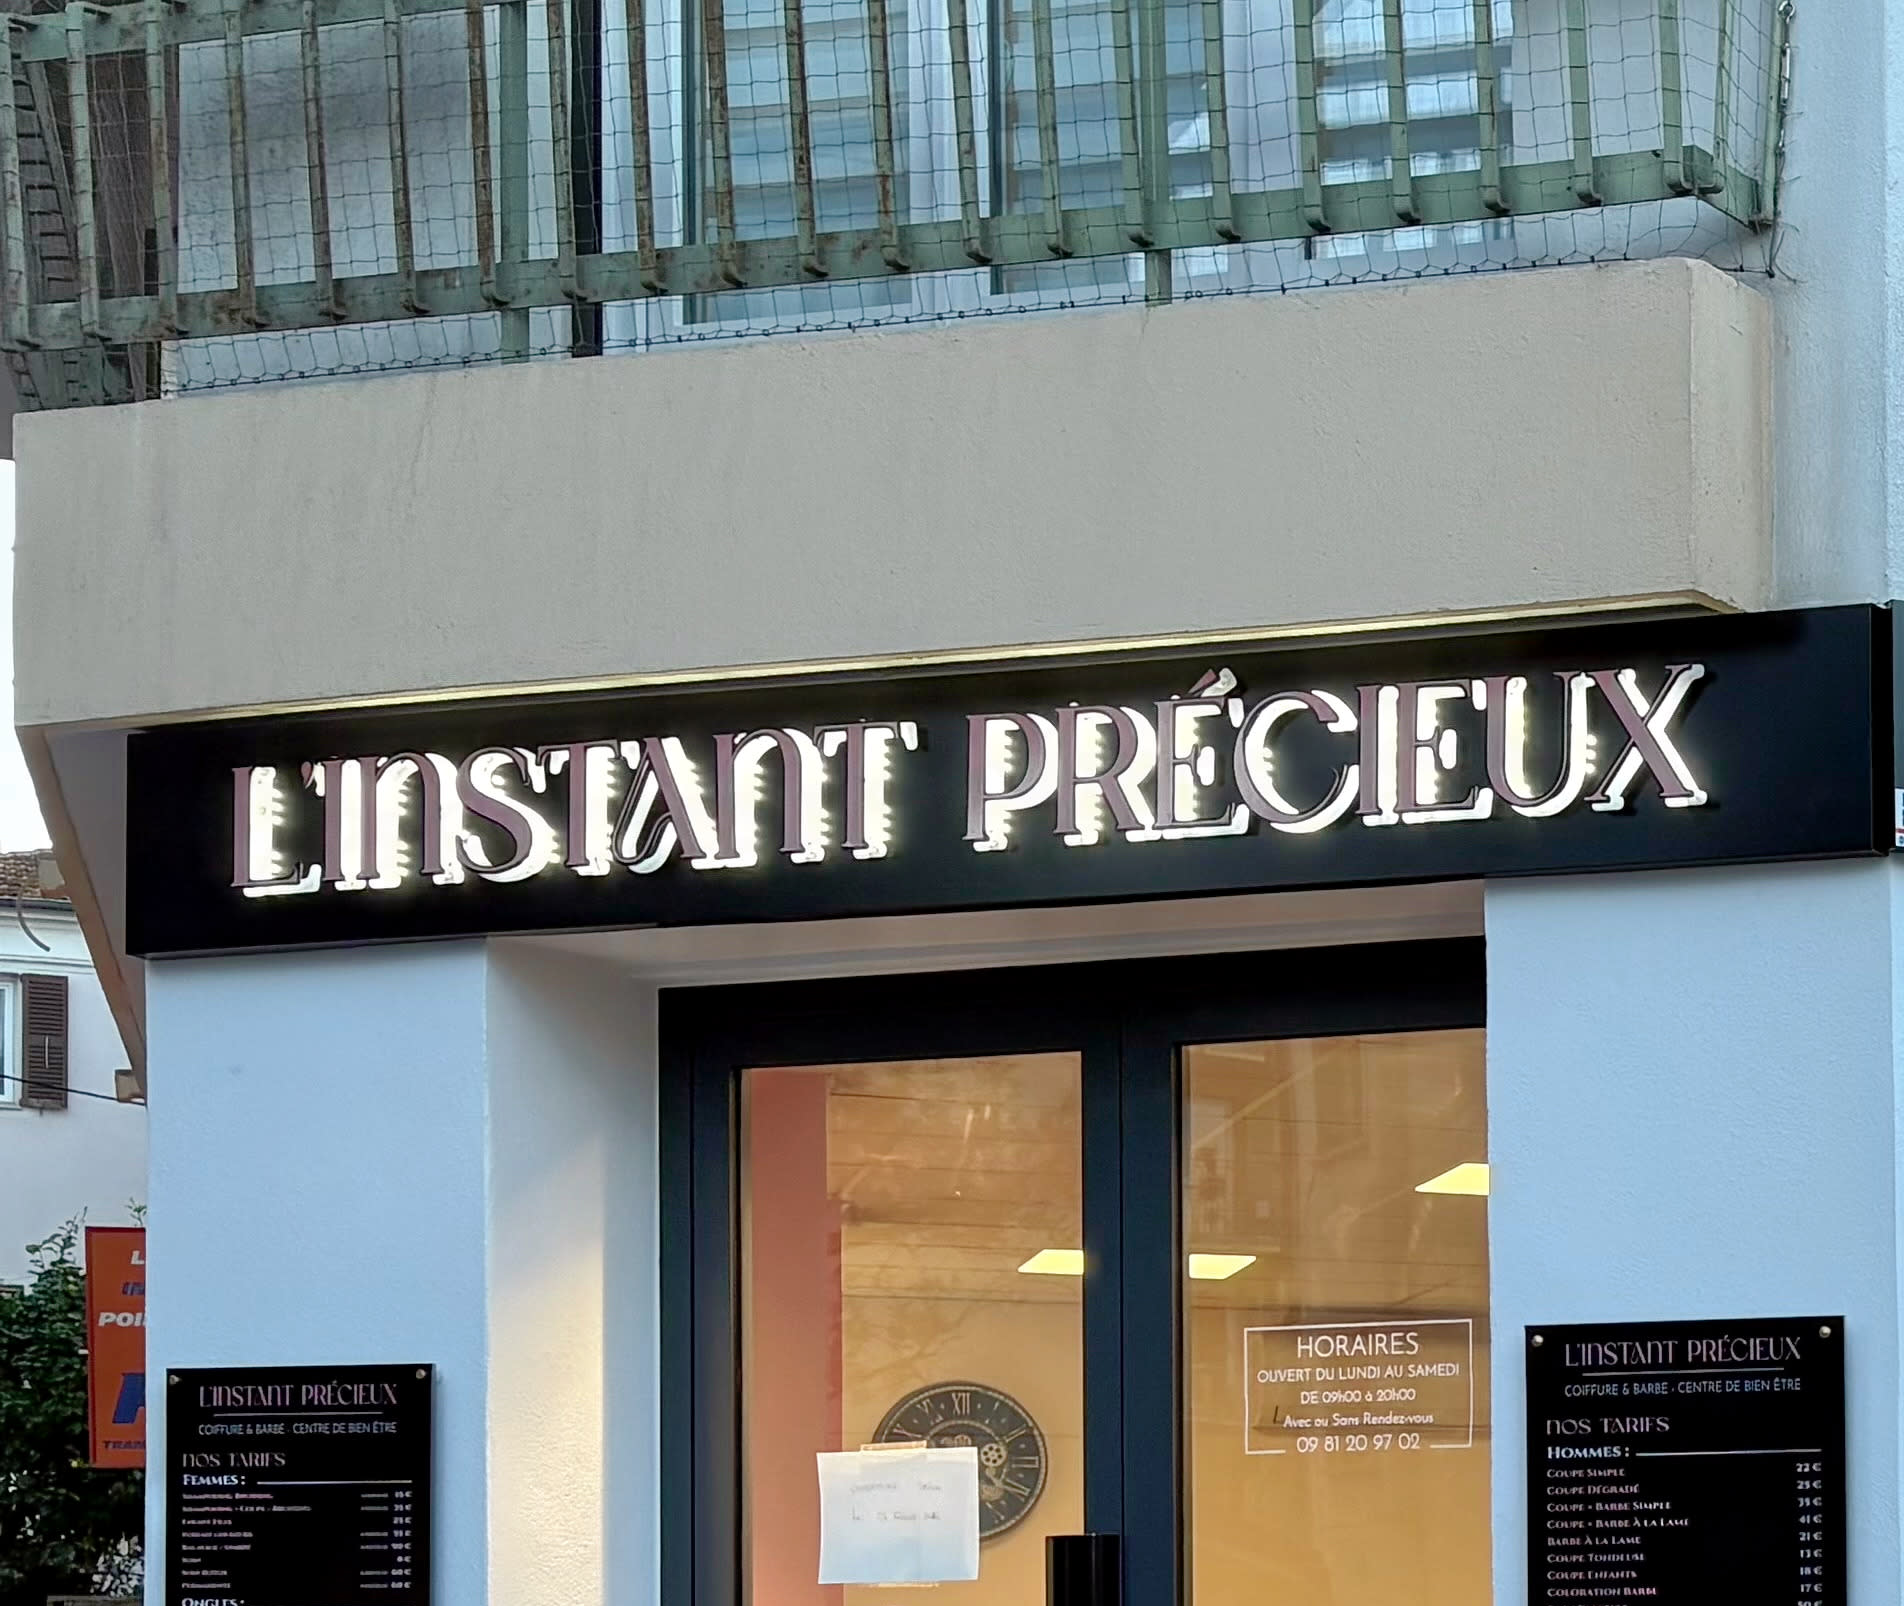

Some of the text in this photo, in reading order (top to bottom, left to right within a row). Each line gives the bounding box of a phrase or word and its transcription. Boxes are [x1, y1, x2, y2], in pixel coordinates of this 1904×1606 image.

[231, 667, 1708, 897] L'INSTANT PRÉCIEUX
[1296, 1332, 1419, 1358] HORAIRES
[1565, 1335, 1800, 1366] L'INSTANT PRÉCIEUX
[1257, 1363, 1460, 1383] OUVERT DU LUNDI AU SAMEDI
[199, 1381, 396, 1407] L'INSTANT PRÉCIEUX
[1300, 1388, 1416, 1405] DE 09h00 à 20h00
[1564, 1377, 1800, 1397] COIFFURE & BARBE CENTRE DE BIEN ÊTRE
[1283, 1411, 1434, 1428] Avec ou Sans Rendez-vous
[1546, 1417, 1669, 1435] NOS TARIFS
[1296, 1432, 1420, 1453] 09 81 20 97 02
[182, 1453, 285, 1467] NOS TARIFS
